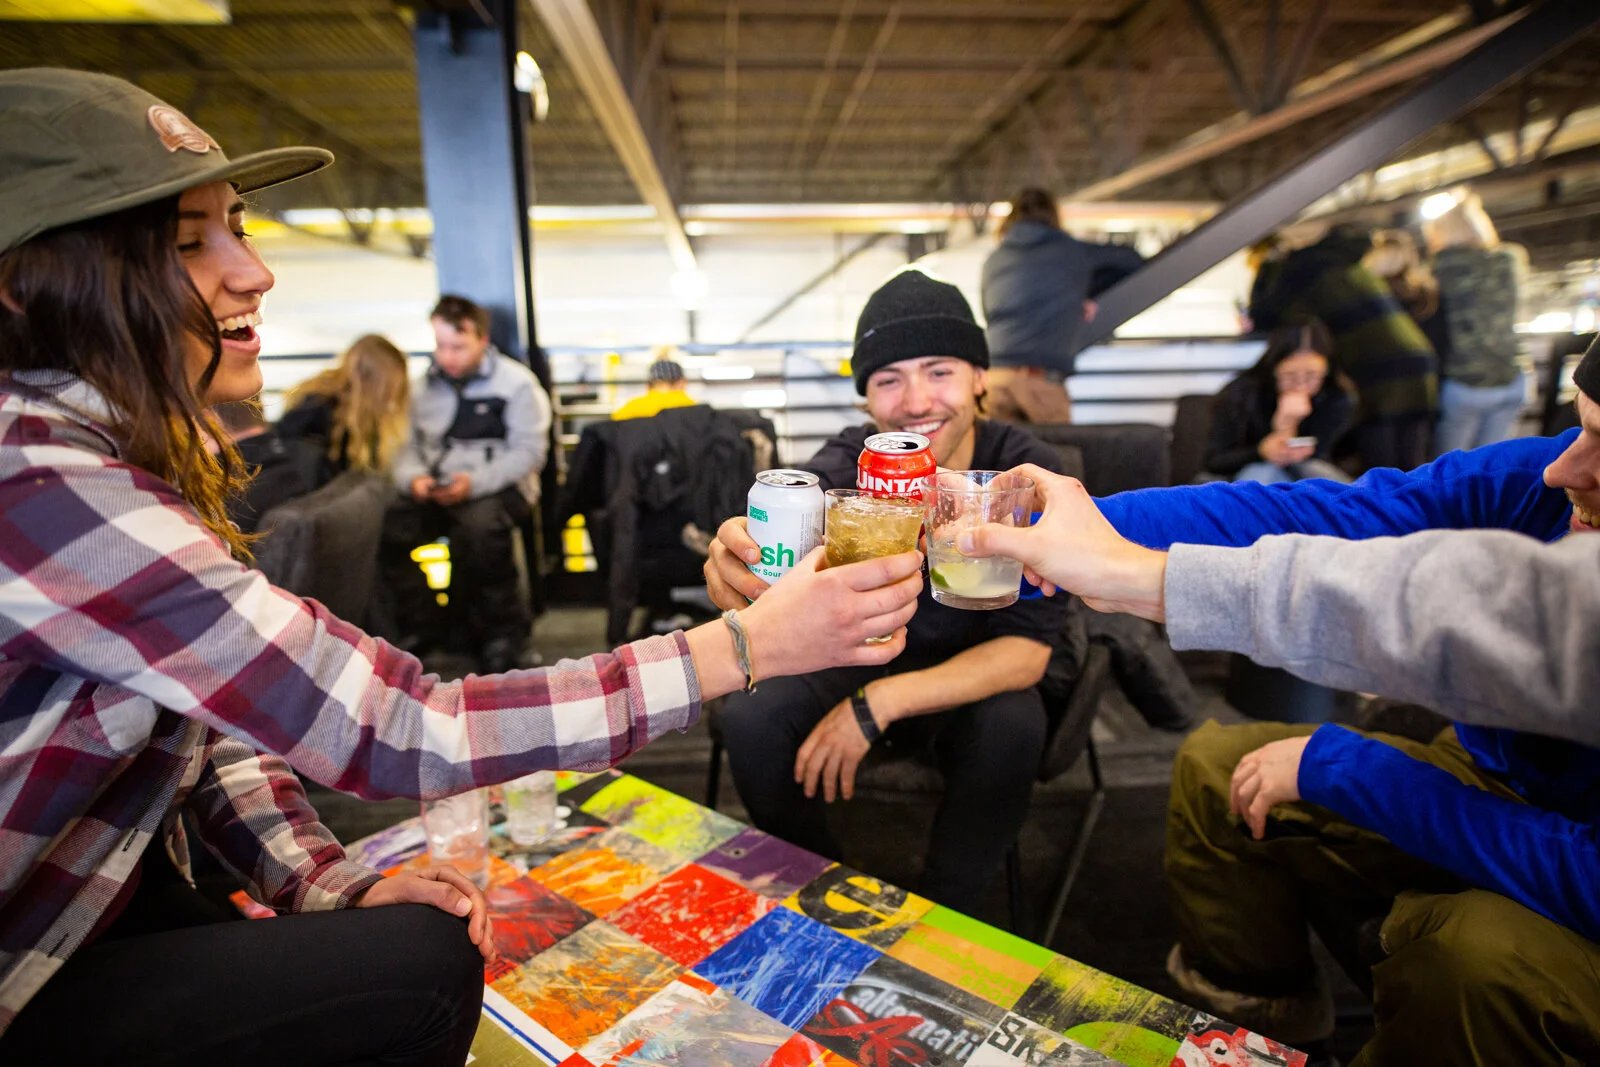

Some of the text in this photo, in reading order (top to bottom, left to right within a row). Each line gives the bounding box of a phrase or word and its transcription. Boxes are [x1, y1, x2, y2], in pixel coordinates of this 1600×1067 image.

[858, 467, 925, 492] UINTA
[763, 568, 782, 578] Sour
[851, 988, 980, 1061] altenati
